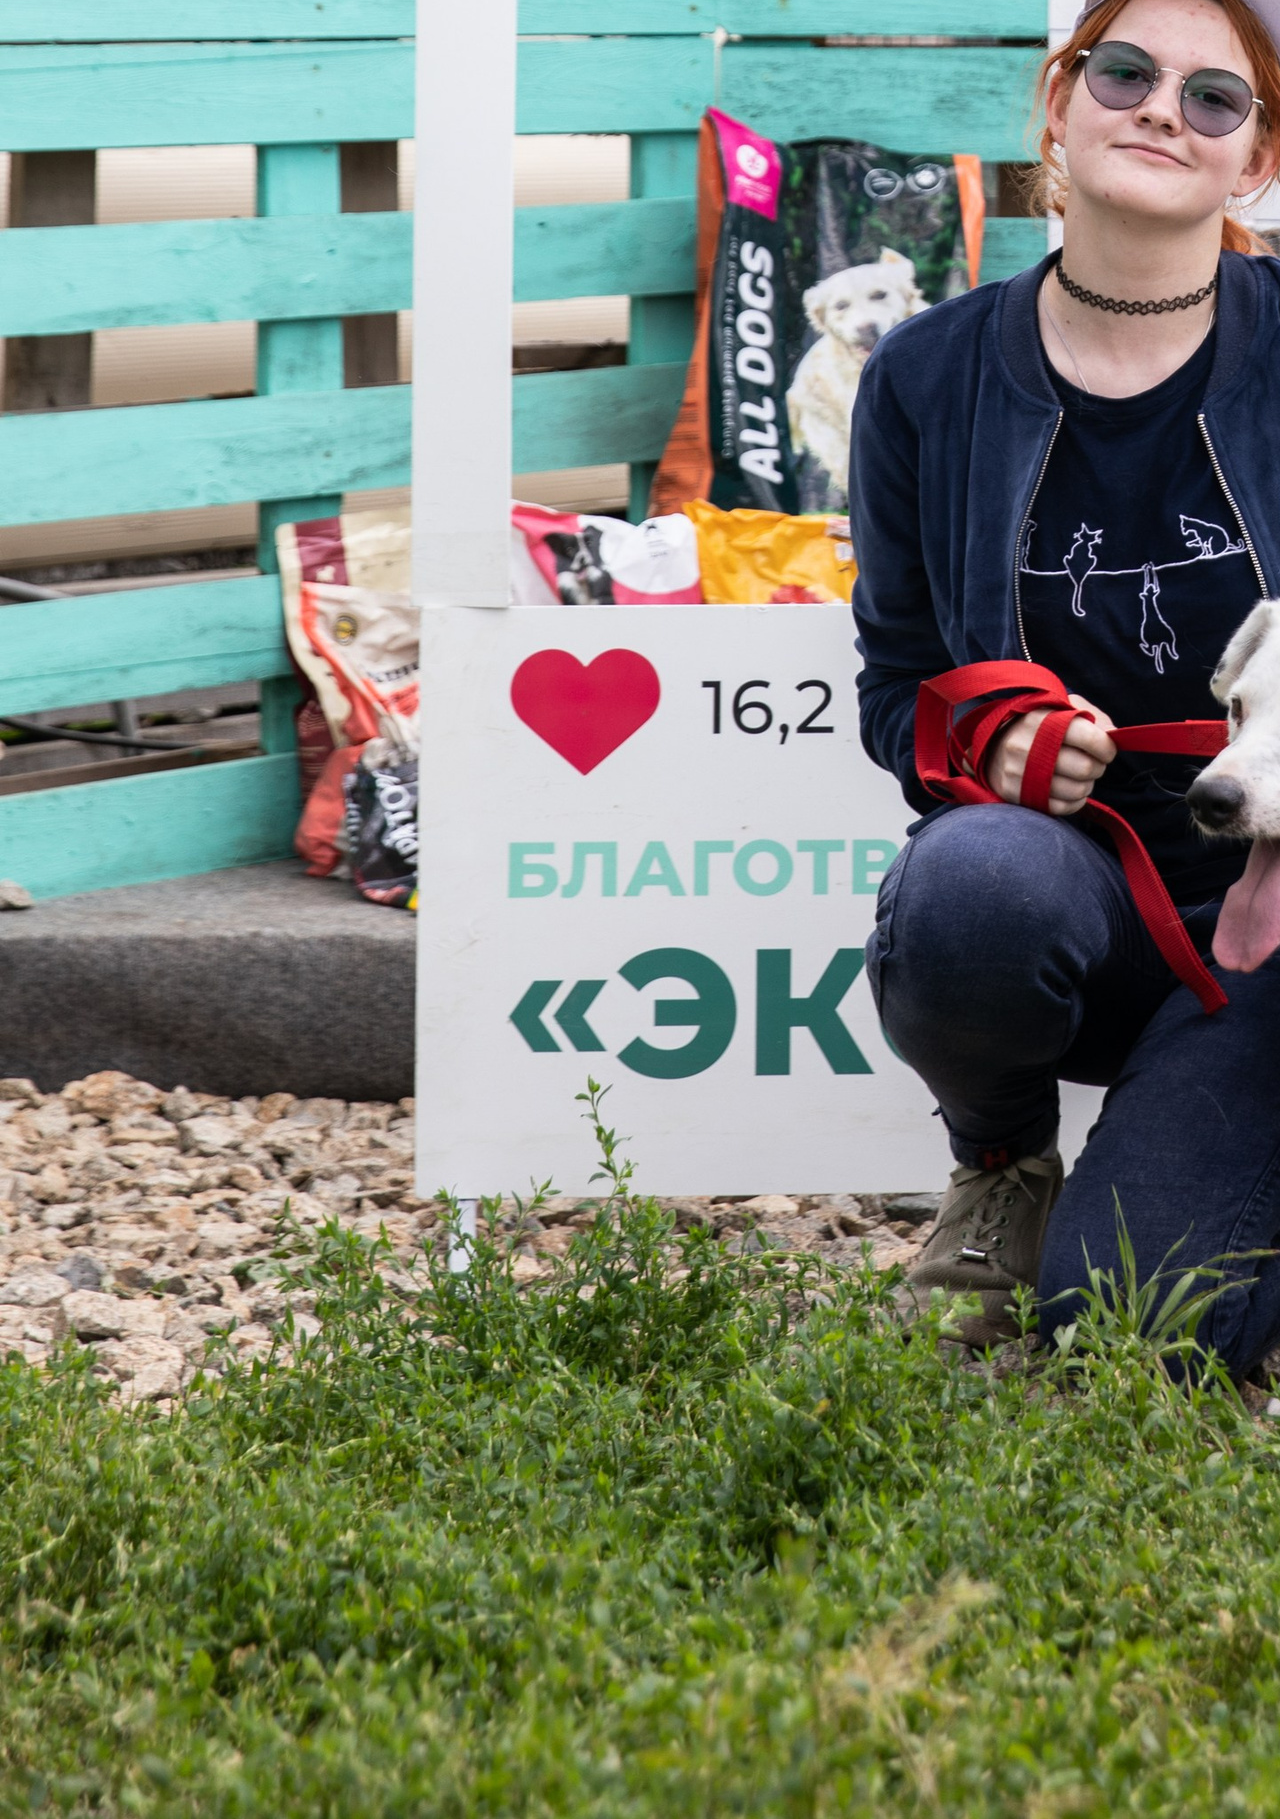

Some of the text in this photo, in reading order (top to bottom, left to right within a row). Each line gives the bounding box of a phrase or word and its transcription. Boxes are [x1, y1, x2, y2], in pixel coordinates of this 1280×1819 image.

[735, 240, 776, 386] DOGS
[737, 396, 785, 484] ALL
[701, 679, 836, 745] 16,2
[509, 947, 915, 1081] «ЭК
